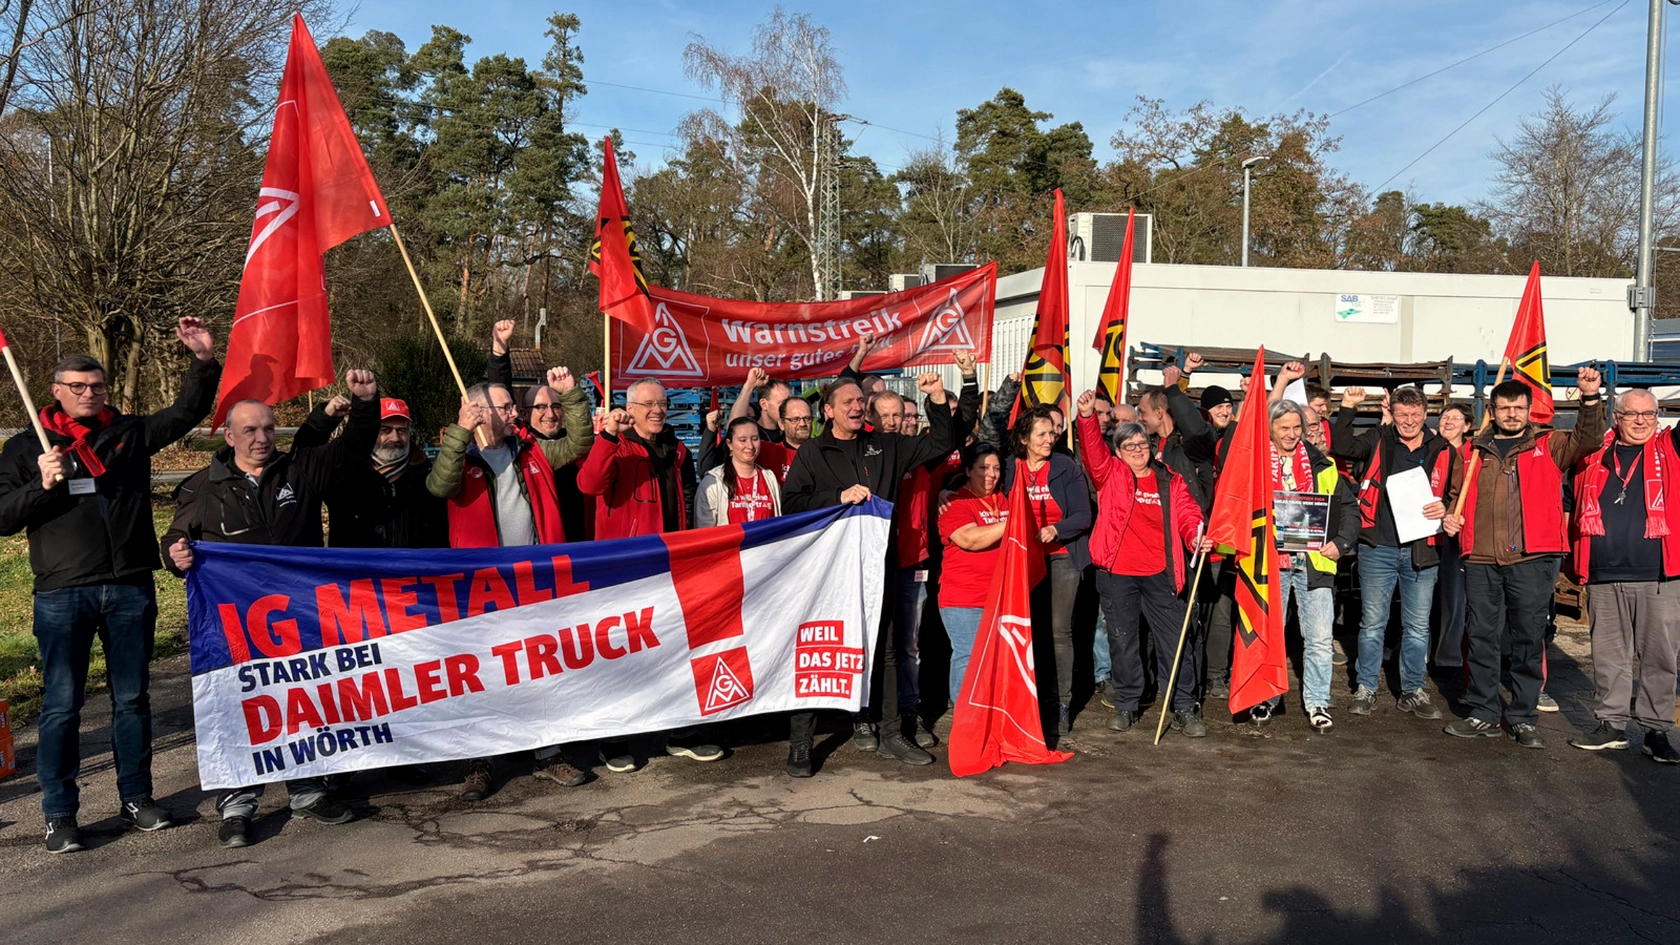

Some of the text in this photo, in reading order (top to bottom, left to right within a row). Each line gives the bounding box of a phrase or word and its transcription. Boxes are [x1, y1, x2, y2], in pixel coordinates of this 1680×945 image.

[721, 311, 903, 345] Warnstreik
[725, 352, 787, 369] unser
[218, 554, 590, 665] IG METALL
[802, 625, 838, 642] WEIL
[238, 642, 382, 692] STARK BEI
[241, 606, 662, 746] DAIMLER TRUCK
[799, 652, 864, 671] DAS JETZ
[799, 674, 849, 695] ZÄHLT.
[252, 722, 394, 776] IN WÖRTH
